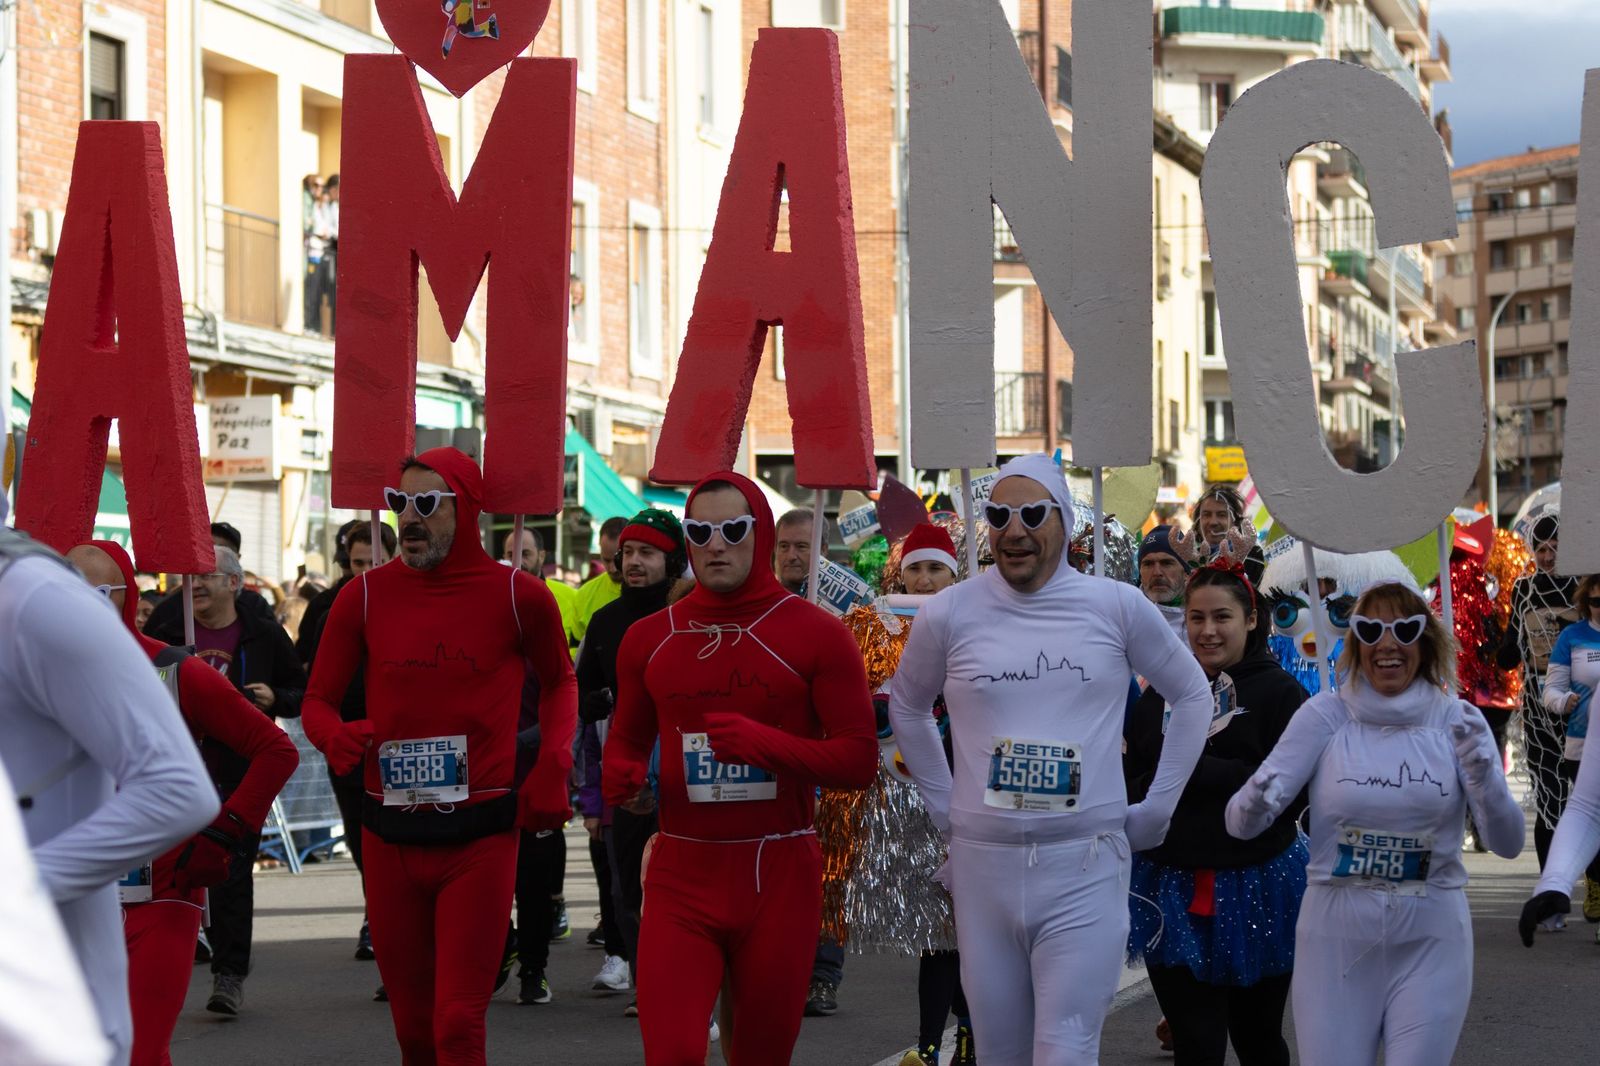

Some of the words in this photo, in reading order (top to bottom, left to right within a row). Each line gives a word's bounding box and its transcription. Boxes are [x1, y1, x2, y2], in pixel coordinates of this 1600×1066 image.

[217, 433, 249, 450] Paz
[827, 566, 860, 592] SETEL
[401, 741, 458, 754] SETEL
[1013, 743, 1072, 758] SETEL
[390, 755, 445, 784] 5588
[999, 757, 1058, 789] 5589
[1362, 834, 1424, 849] SETEL
[1349, 847, 1405, 879] 5158
